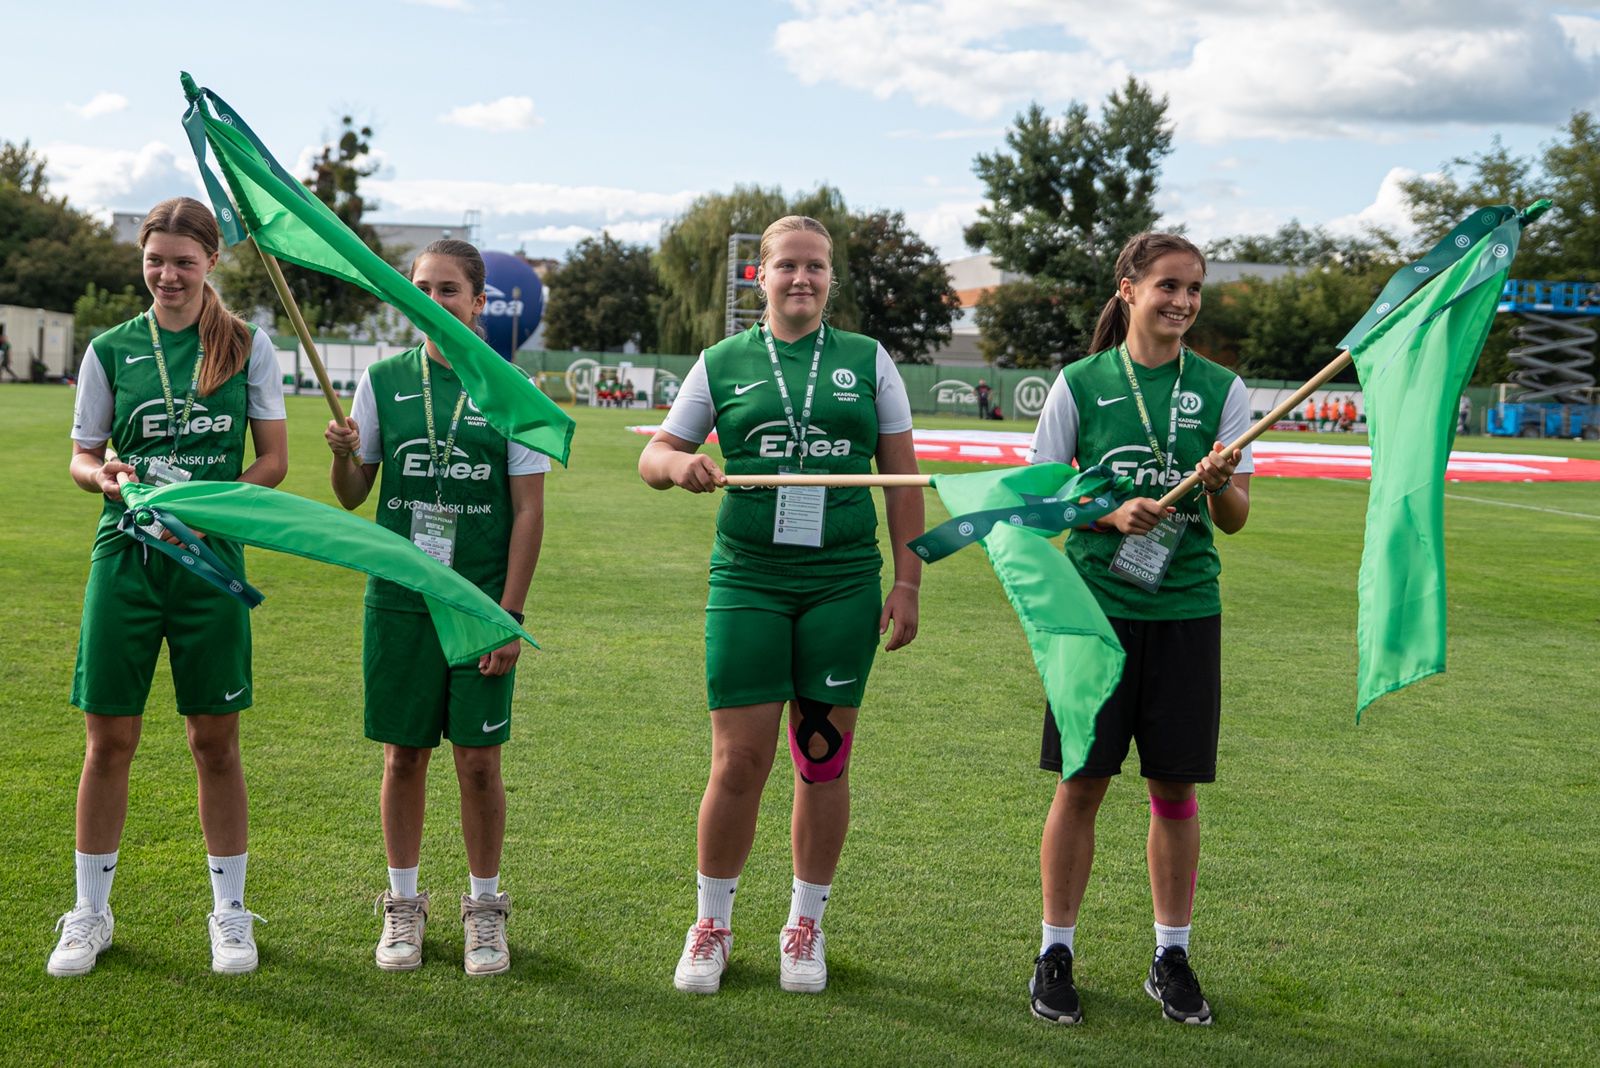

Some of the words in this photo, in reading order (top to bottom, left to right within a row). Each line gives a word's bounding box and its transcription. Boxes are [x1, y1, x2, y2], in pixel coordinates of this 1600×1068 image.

[937, 389, 979, 404] Ene
[759, 435, 851, 457] Enea
[467, 505, 492, 514] BANK
[1175, 513, 1201, 523] BANK
